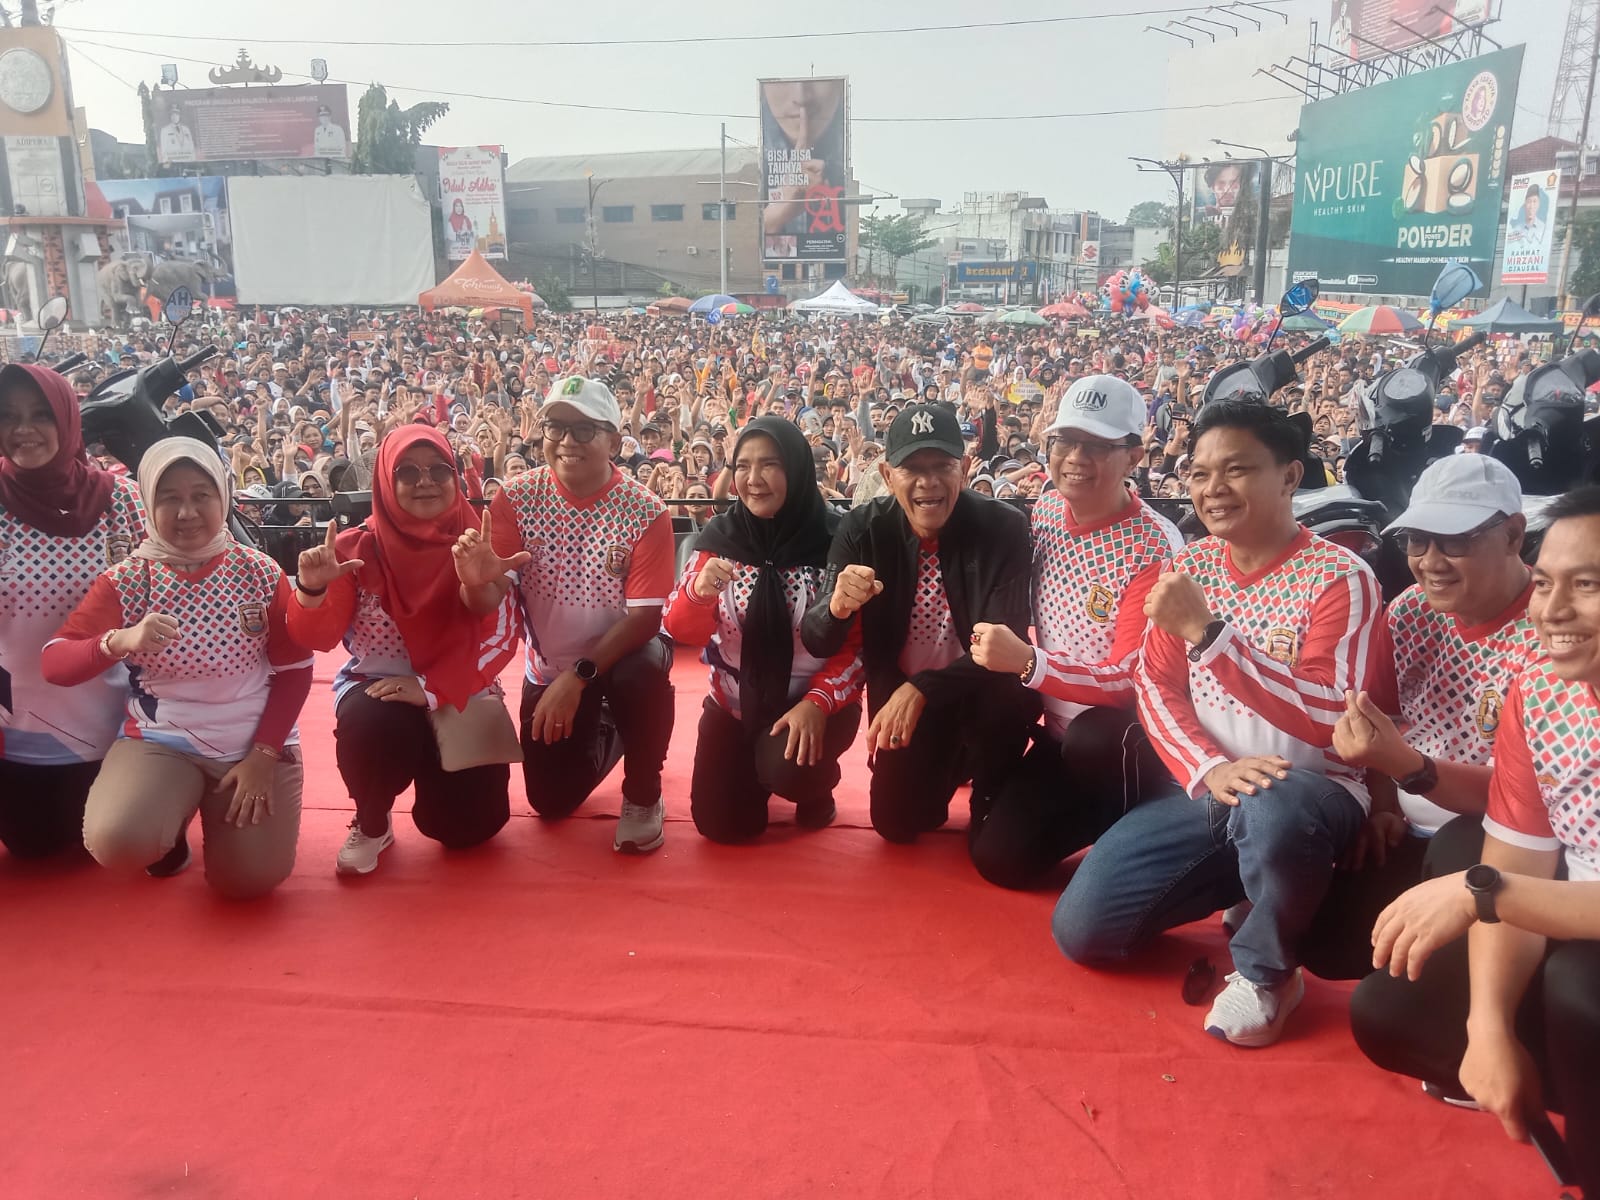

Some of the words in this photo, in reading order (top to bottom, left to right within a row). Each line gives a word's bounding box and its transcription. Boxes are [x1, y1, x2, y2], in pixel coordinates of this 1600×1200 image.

[768, 161, 802, 174] TAUNYA
[768, 174, 786, 186] GAK
[789, 173, 810, 186] BISA
[1313, 205, 1343, 217] HEALTHY
[1347, 203, 1366, 214] SKIN
[1397, 223, 1473, 249] POWDER
[1507, 256, 1544, 265] MIRZANI
[1075, 390, 1107, 407] UIN
